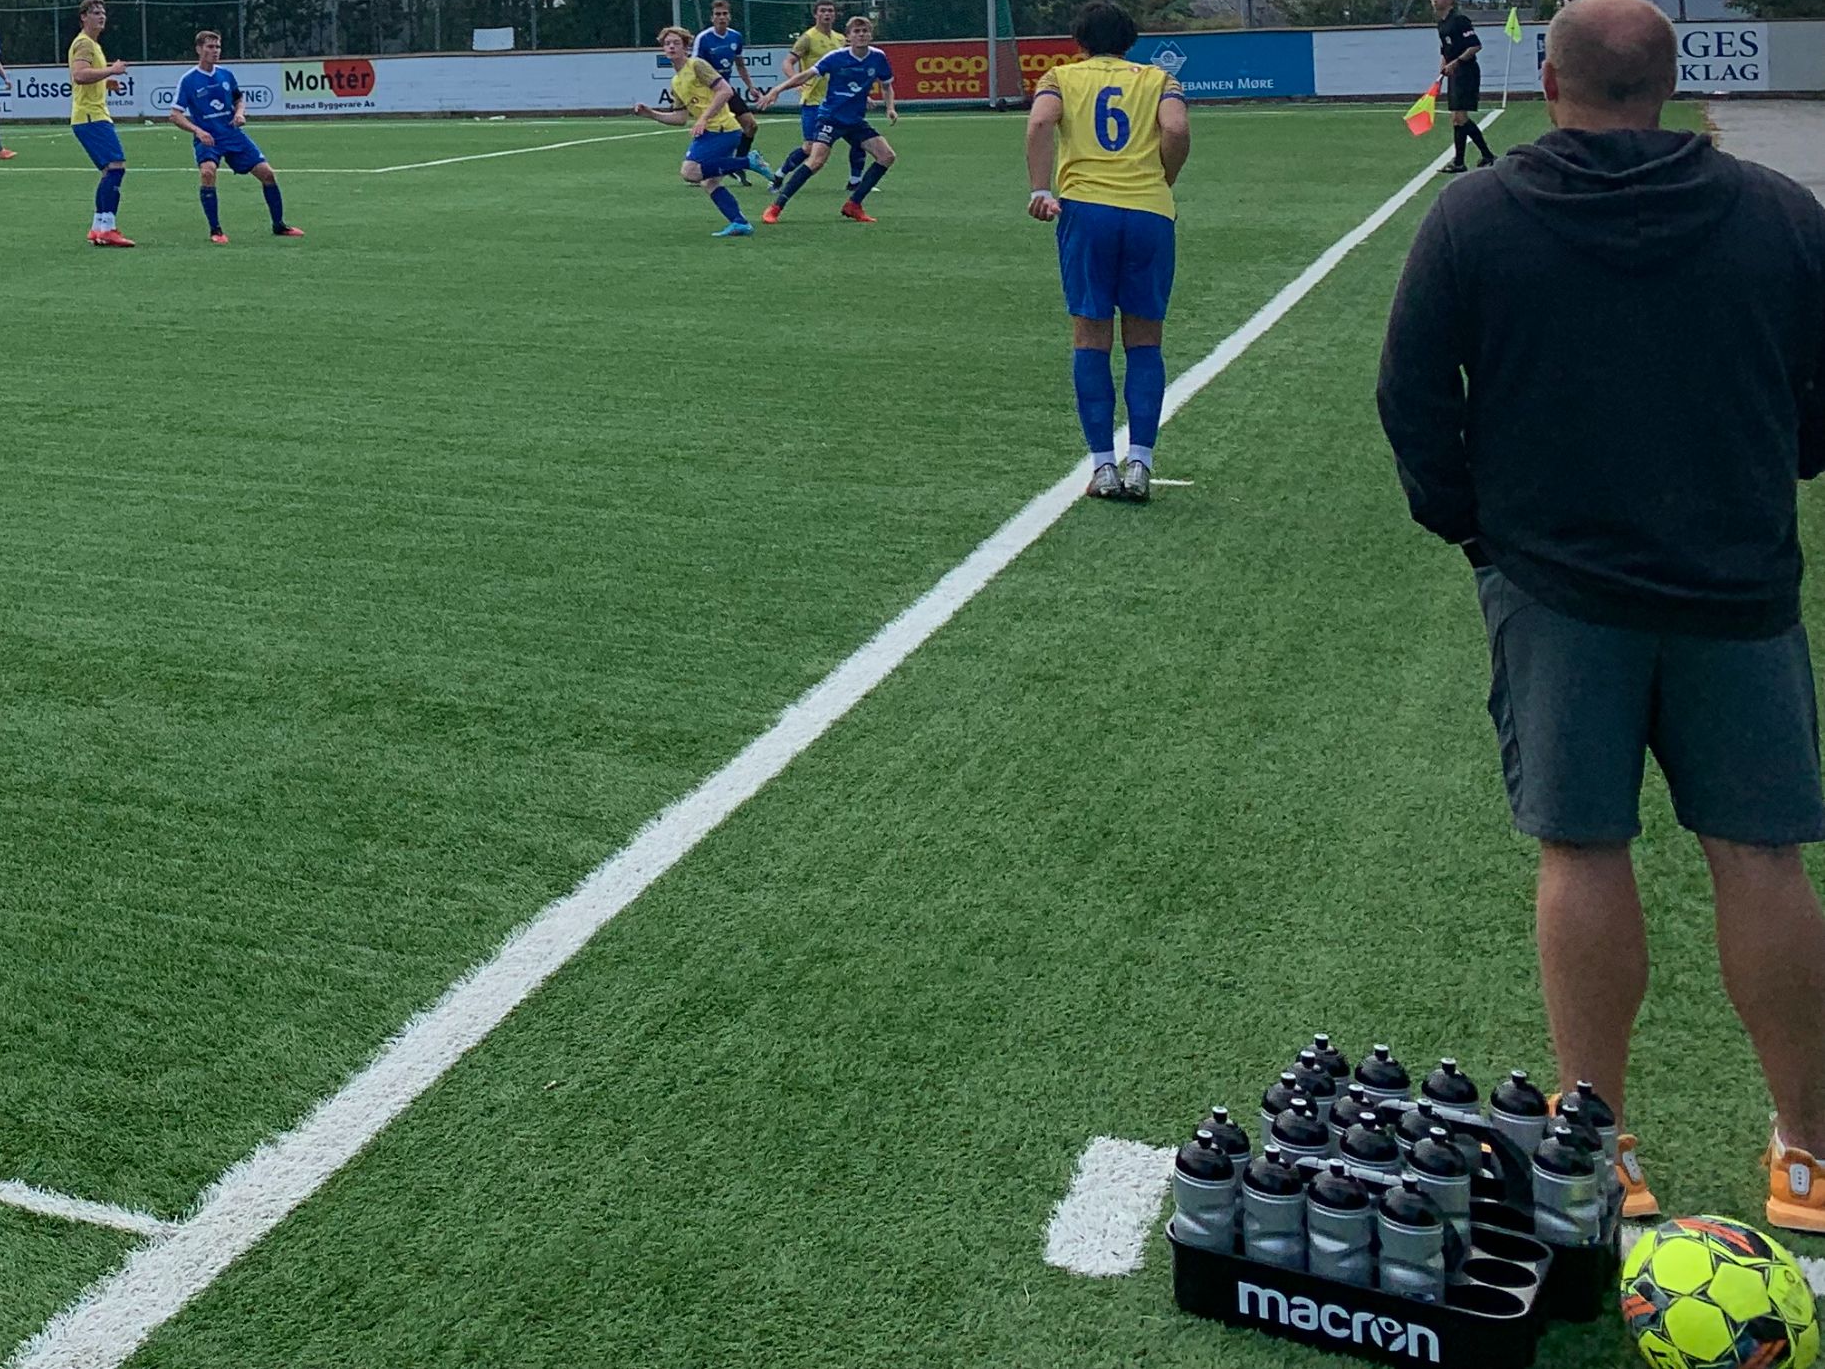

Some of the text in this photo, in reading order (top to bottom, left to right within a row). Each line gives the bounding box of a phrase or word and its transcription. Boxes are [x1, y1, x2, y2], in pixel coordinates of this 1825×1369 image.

[1677, 30, 1759, 59] GES
[915, 55, 989, 76] coop
[1680, 63, 1759, 81] KLAG
[285, 66, 370, 92] Montér
[917, 77, 981, 93] extra
[1181, 80, 1234, 91] EBANKEN
[1094, 86, 1131, 152] 6
[1237, 1281, 1441, 1364] macron
